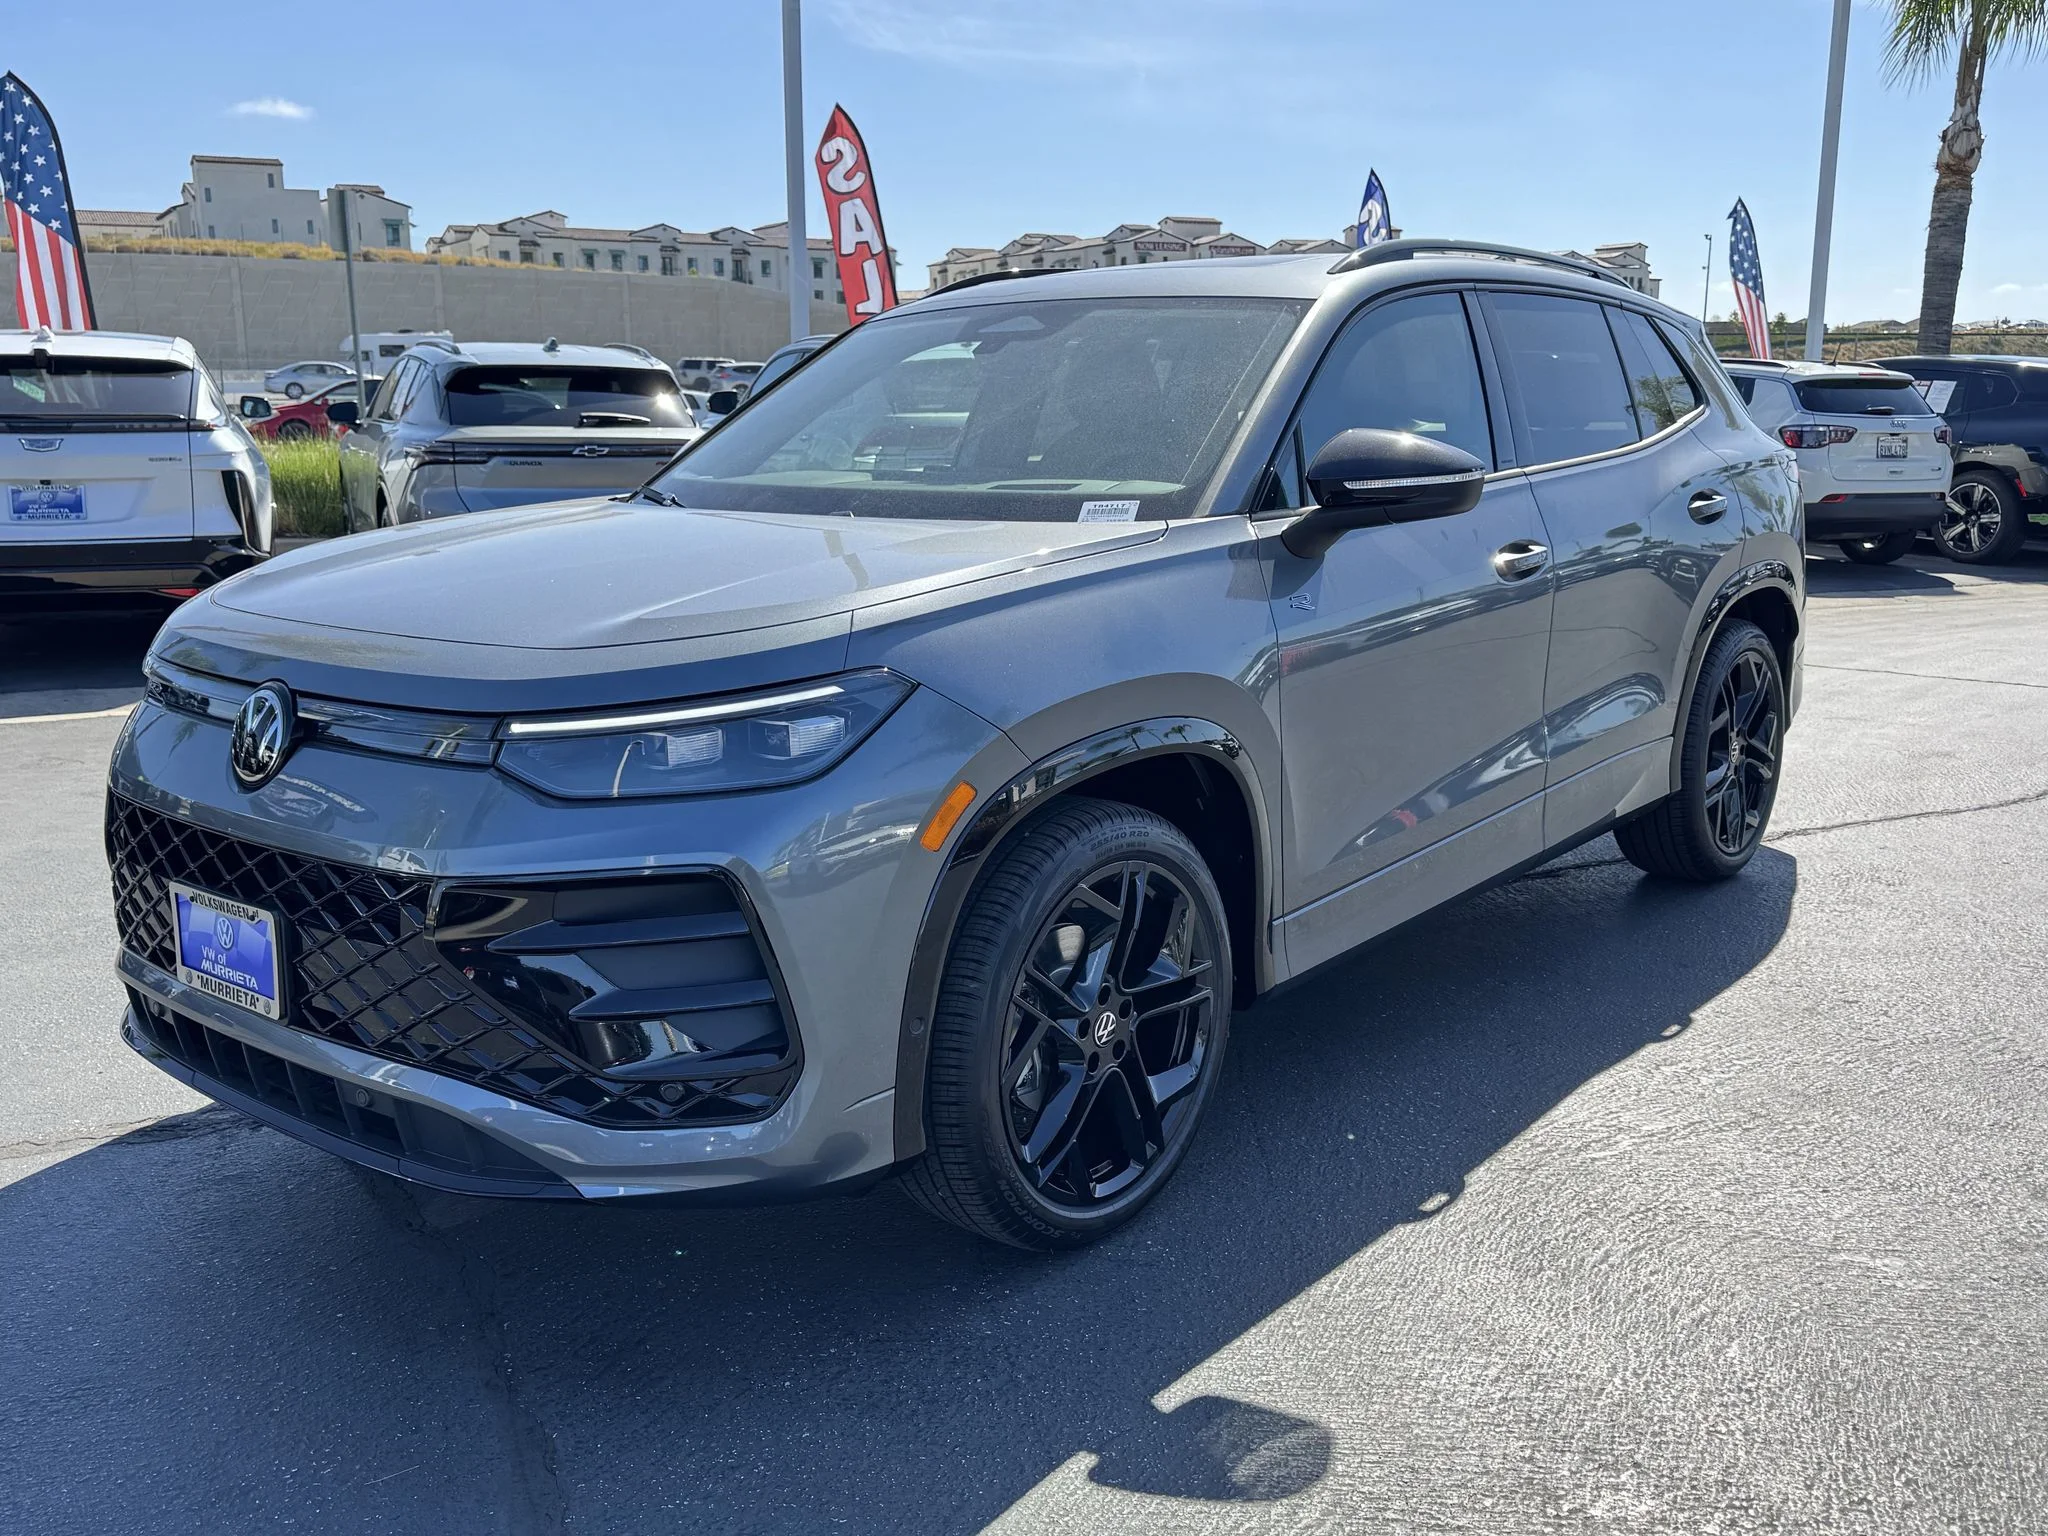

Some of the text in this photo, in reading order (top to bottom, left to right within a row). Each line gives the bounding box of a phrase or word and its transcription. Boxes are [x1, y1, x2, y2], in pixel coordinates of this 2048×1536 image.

[192, 891, 250, 919] VOLKSWAGEN
[202, 945, 226, 965] VW of
[201, 959, 258, 990] MURRIETA
[997, 1179, 1065, 1238] SCORPION
